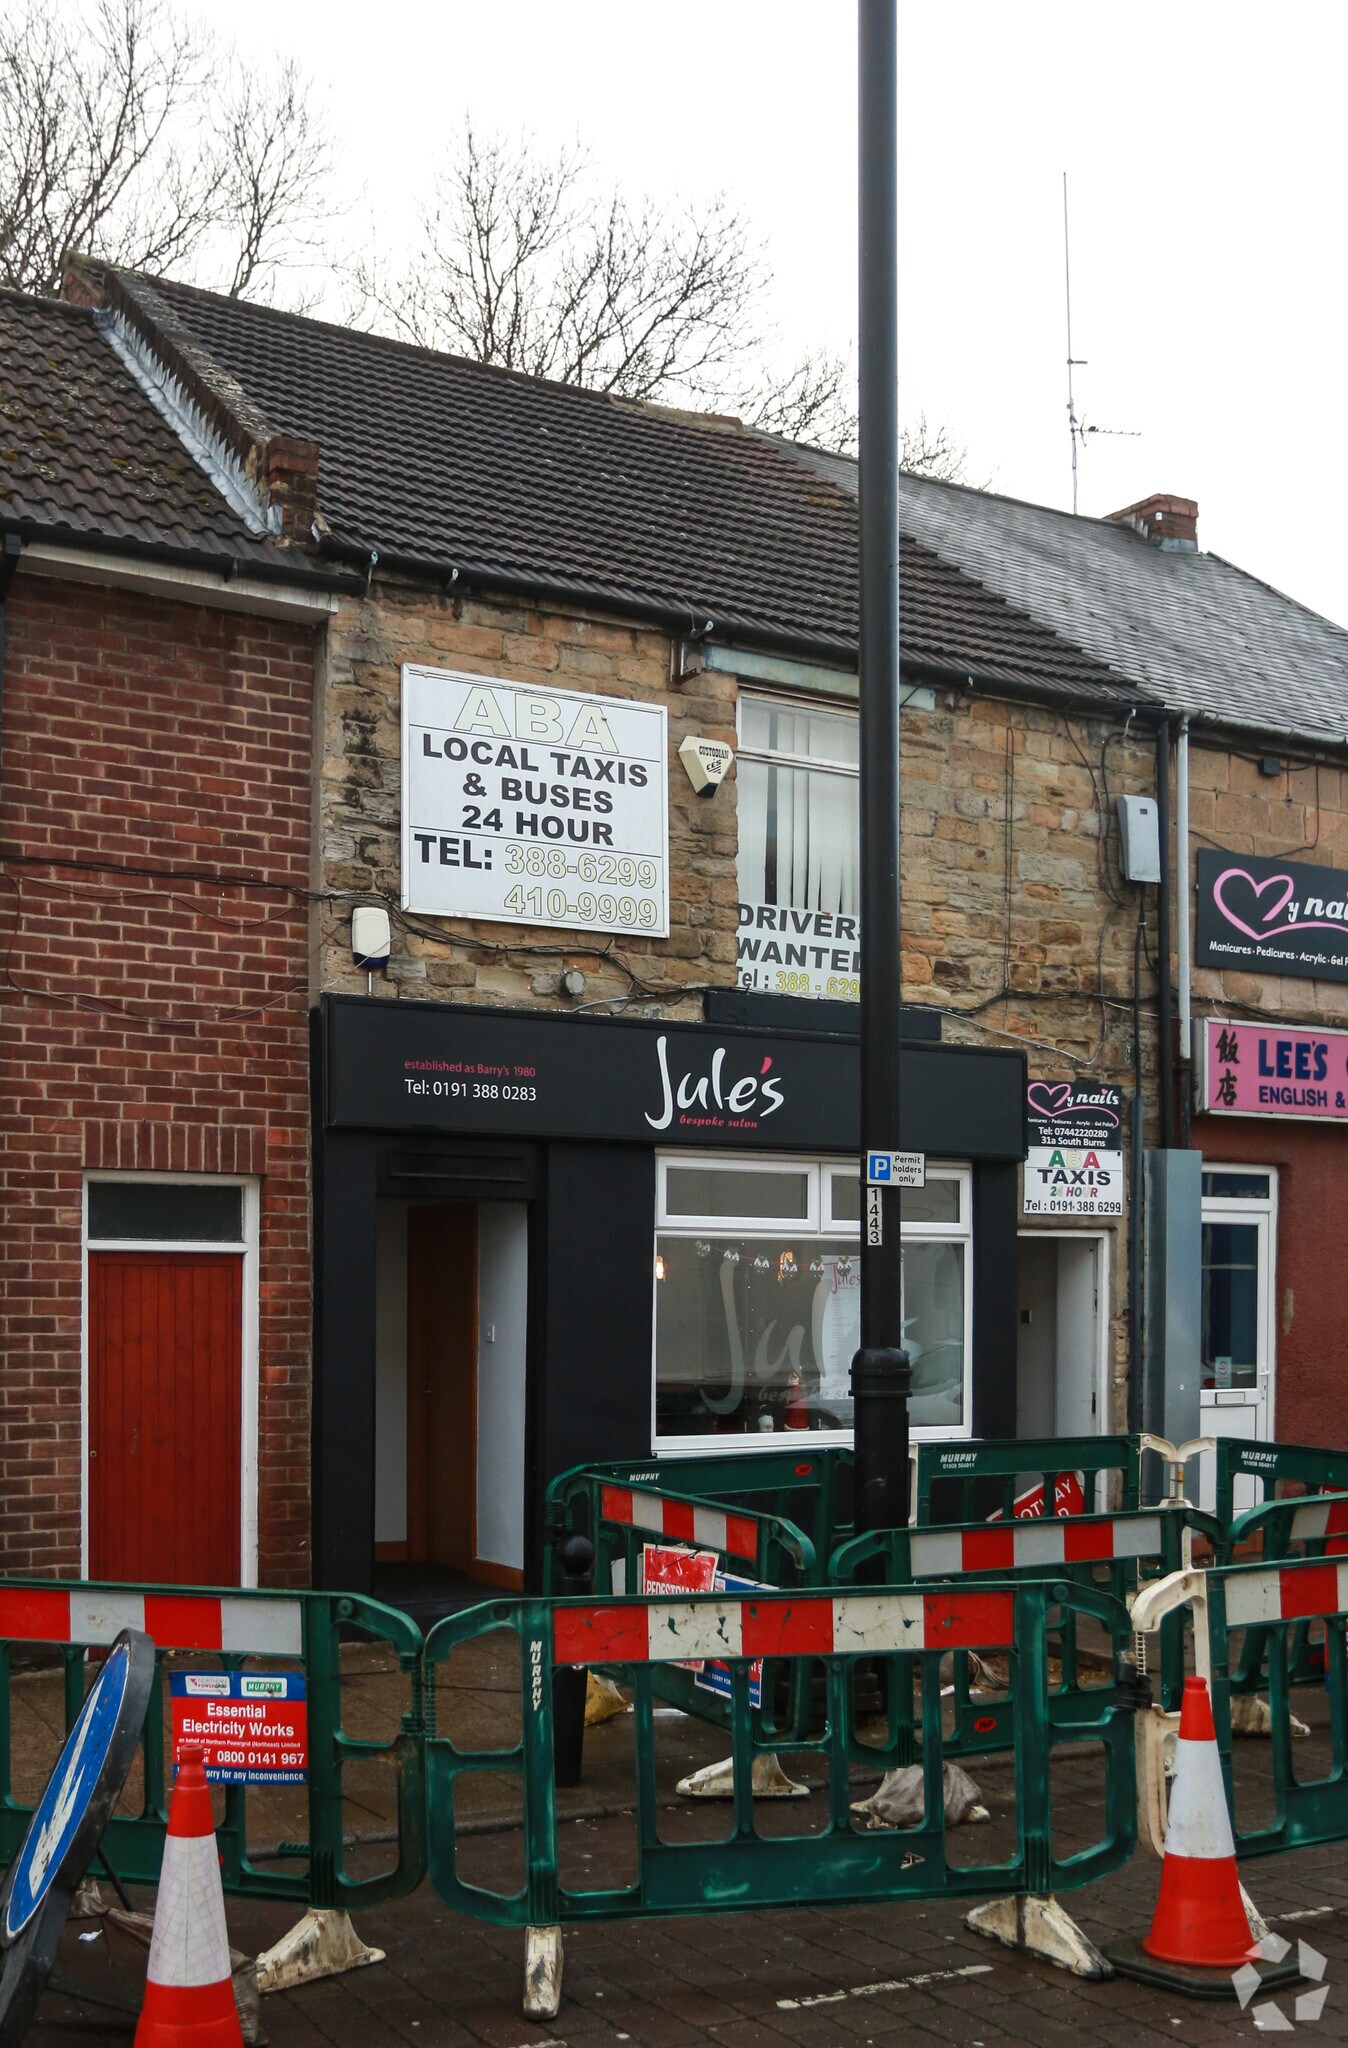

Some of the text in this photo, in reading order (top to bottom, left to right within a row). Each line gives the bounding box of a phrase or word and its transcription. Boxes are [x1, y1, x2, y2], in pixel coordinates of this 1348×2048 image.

[453, 686, 619, 753] ABA
[423, 733, 648, 787] LOCAL TAXIS
[699, 745, 729, 759] CUSTODIAN
[462, 772, 614, 814] & BUSES
[462, 805, 614, 846] 24 HOUR
[414, 833, 657, 889] TEL: 388-6299
[504, 885, 657, 927] 410-9999
[739, 903, 860, 941] DRIVER
[1209, 941, 1251, 955] Manicures
[1256, 946, 1295, 959] Pedicures
[1300, 952, 1326, 965] Acrylic
[1331, 955, 1343, 966] Gel
[775, 971, 809, 993] 388
[404, 1060, 536, 1077] established as Barry's 1980
[1259, 1039, 1328, 1081] LEE'S
[404, 1079, 537, 1101] Tel: 0191 388 0283
[644, 1036, 784, 1129] Jule's
[1076, 1089, 1119, 1105] nails
[1259, 1085, 1345, 1108] ENGLISH &
[680, 1114, 758, 1128] bespoke salon
[1038, 1126, 1053, 1135] Tel:
[1041, 1136, 1106, 1147] 31a South Burns
[895, 1155, 921, 1164] Permit
[1048, 1149, 1100, 1168] ABA
[875, 1158, 888, 1178] P
[893, 1165, 922, 1174] holders
[898, 1175, 916, 1184] only
[1037, 1169, 1111, 1186] TAXIS
[1066, 1186, 1098, 1198] HOUR
[1050, 1200, 1073, 1211] 0191
[1077, 1201, 1094, 1212] 388
[1098, 1201, 1121, 1213] 6299
[940, 1453, 977, 1462] MURPHY
[1241, 1451, 1278, 1462] MURPHY
[629, 1472, 660, 1481] MURPHY
[530, 1641, 542, 1711] MURPHY
[248, 1683, 280, 1691] MURPHY
[207, 1702, 266, 1718] Essential
[182, 1719, 294, 1738] Electricity Works
[217, 1750, 245, 1764] 0800
[248, 1751, 276, 1764] 0141
[281, 1753, 305, 1765] 967
[206, 1770, 219, 1779] orry
[222, 1769, 231, 1778] for
[233, 1771, 246, 1781] any
